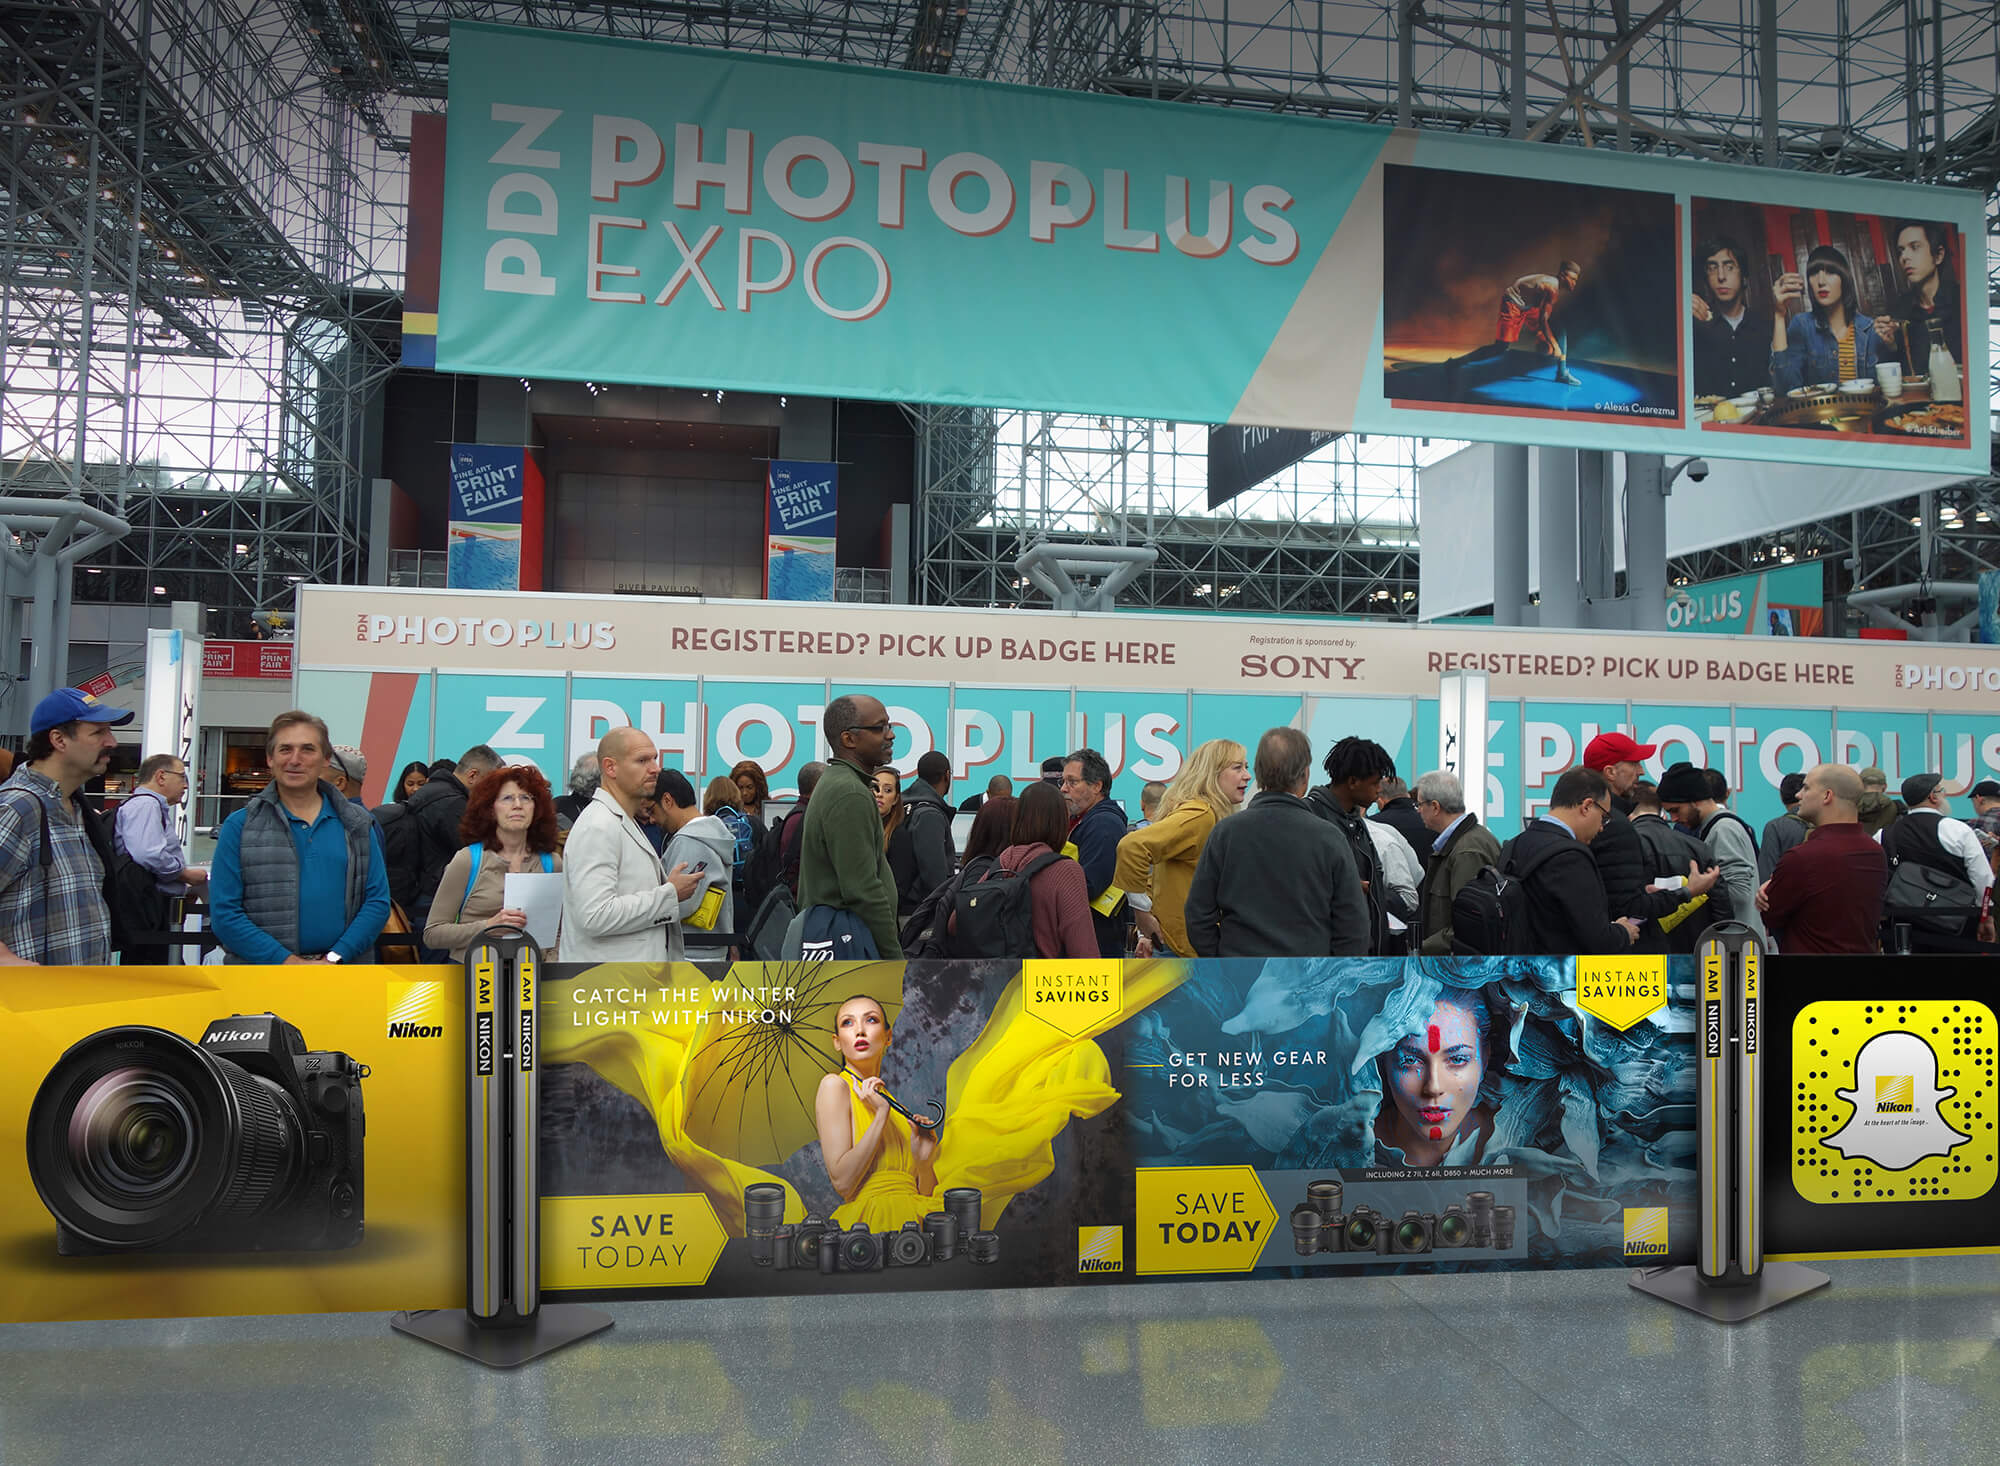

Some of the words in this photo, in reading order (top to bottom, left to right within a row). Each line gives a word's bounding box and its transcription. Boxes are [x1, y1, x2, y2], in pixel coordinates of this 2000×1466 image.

[483, 103, 563, 295] PDN
[591, 113, 1300, 266] PHOTOPLUS
[586, 213, 892, 321] EXPO
[1603, 401, 1630, 412] Alexis
[1631, 403, 1676, 416] Cuarezma
[454, 469, 475, 480] FINE
[475, 464, 492, 474] ART
[456, 464, 517, 494] PRINT
[461, 484, 508, 507] FAIR
[775, 480, 832, 509] PRINT
[779, 499, 823, 522] FAIR
[357, 614, 368, 641] PDN
[370, 614, 616, 650] PHOTOPLUS
[671, 627, 870, 655] REGISTERED?
[879, 633, 946, 657] PICK
[955, 636, 992, 659] UP
[1001, 638, 1096, 662] BADGE
[1105, 641, 1176, 665] HERE
[1250, 635, 1294, 646] Registration
[1305, 638, 1344, 648] sponsored
[1345, 639, 1357, 648] by:
[1241, 654, 1365, 680] SONY
[1428, 651, 1596, 677] REGISTERED?
[1603, 656, 1660, 679] PICK
[1668, 659, 1699, 680] UP
[1706, 661, 1787, 682] BADGE
[1795, 663, 1855, 685] HERE
[1895, 664, 1904, 688] PDN
[1035, 974, 1109, 987] INSTANT
[1584, 970, 1660, 983] INSTANT
[1708, 970, 1718, 993] AM
[1748, 969, 1755, 991] AM
[479, 978, 490, 1004] AM
[523, 977, 531, 1002] AM
[572, 988, 646, 1004] CATCH
[659, 988, 699, 1002] THE
[712, 987, 796, 1002] WINTER
[1035, 990, 1110, 1003] SAVINGS
[1583, 985, 1660, 998] SAVINGS
[573, 1010, 640, 1026] LIGHT
[652, 1010, 709, 1025] WITH
[722, 1009, 793, 1025] NIKON
[1747, 1003, 1755, 1050] NIKON
[206, 1031, 265, 1043] Nikon
[389, 1023, 442, 1038] Nikon
[522, 1015, 531, 1067] NIKON
[1708, 1005, 1718, 1054] NIKON
[479, 1017, 490, 1071] NIKON
[1169, 1053, 1207, 1067] GET
[1218, 1052, 1263, 1066] NEW
[1273, 1051, 1327, 1066] GEAR
[1169, 1073, 1208, 1088] FOR
[1220, 1072, 1264, 1087] LESS
[1876, 1102, 1912, 1113] Nikon
[1366, 1171, 1405, 1179] INCLUDING
[1469, 1169, 1492, 1177] MUCH
[1494, 1167, 1513, 1176] MORE
[1175, 1192, 1245, 1215] SAVE
[590, 1214, 673, 1237] SAVE
[1159, 1220, 1261, 1245] TODAY
[577, 1244, 687, 1269] TODAY
[1625, 1241, 1666, 1254] Nikon
[1080, 1258, 1122, 1271] Nikon
